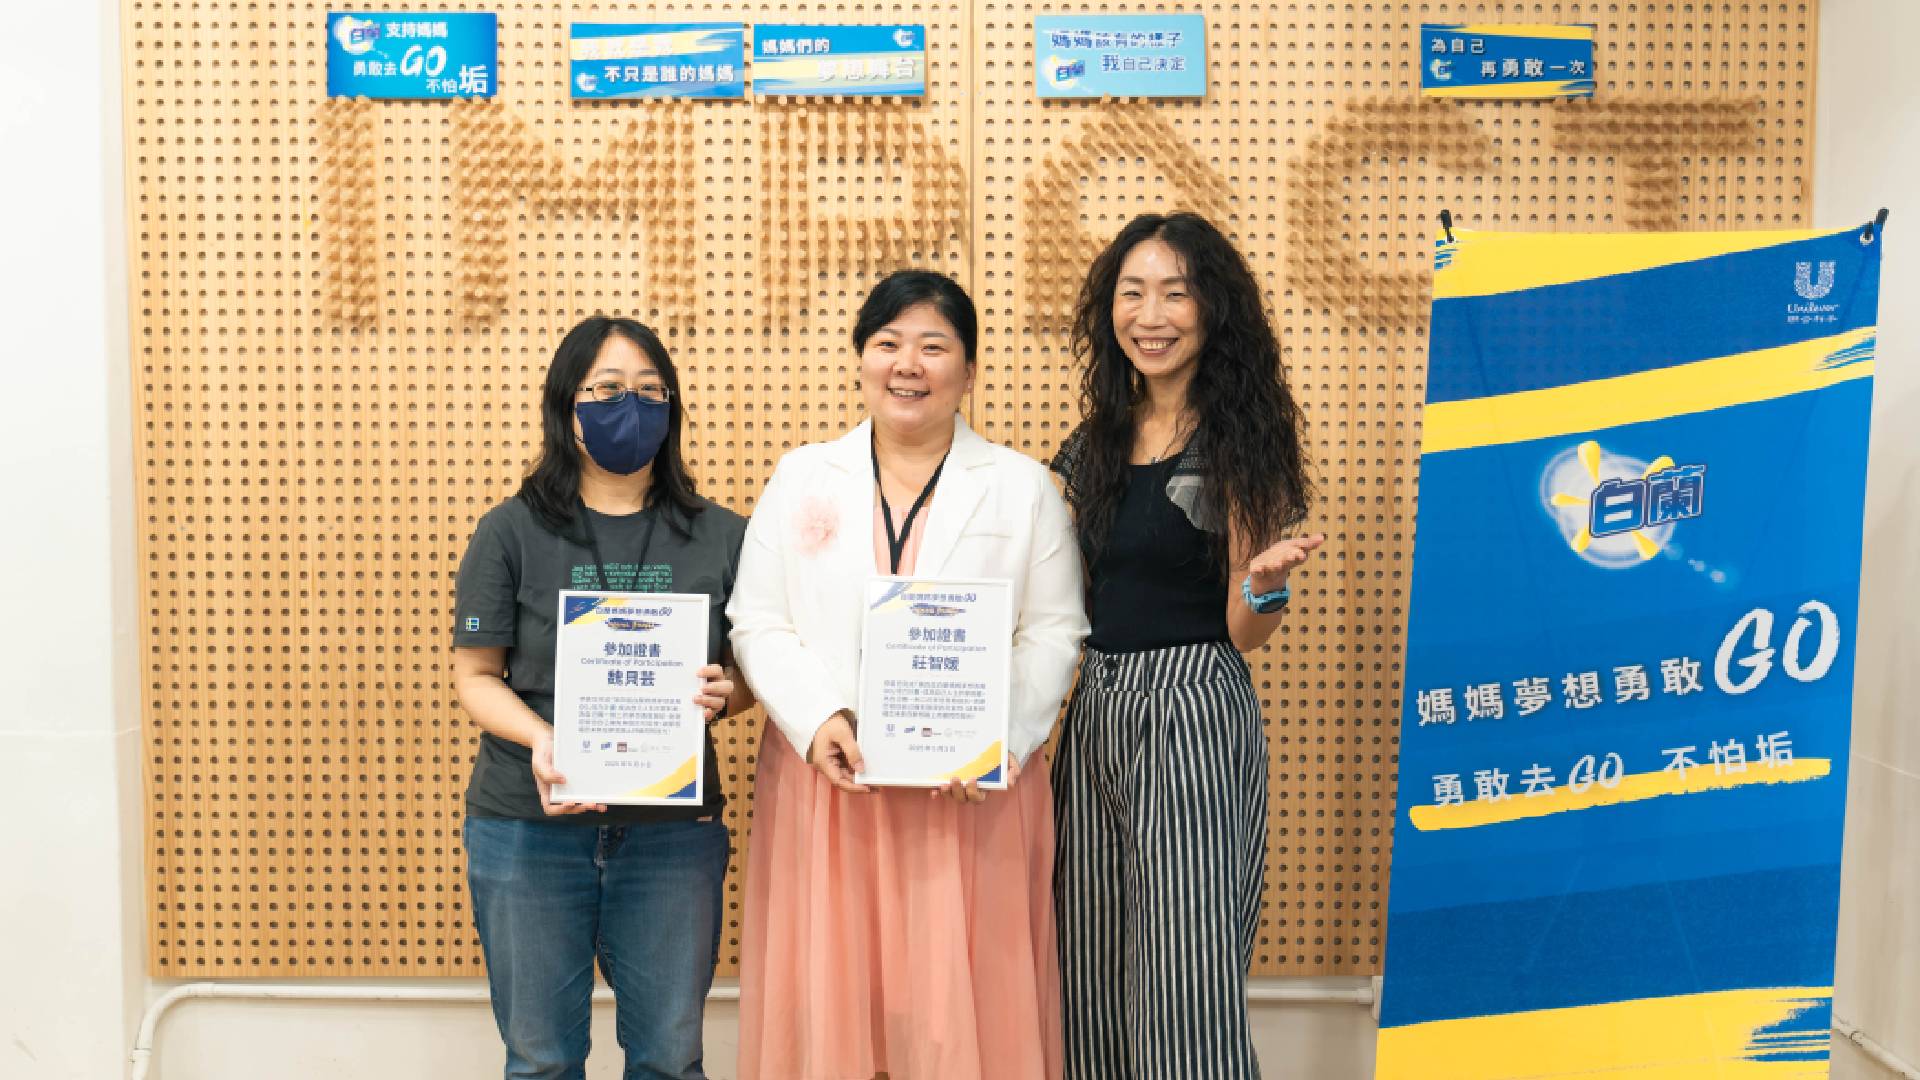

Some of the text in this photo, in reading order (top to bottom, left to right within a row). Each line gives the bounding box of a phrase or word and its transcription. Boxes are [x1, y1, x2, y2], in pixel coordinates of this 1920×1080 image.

[384, 21, 448, 38] 支持媽媽
[762, 38, 830, 54] 媽媽們的
[1051, 30, 1182, 49] 媽媽該有的樣子
[1431, 38, 1484, 54] 為自己
[1102, 54, 1185, 72] 我自己決定
[1481, 58, 1586, 78] 再勇敢一次
[604, 64, 734, 83] 不只是誰的媽媽
[1589, 464, 1707, 539] 白蘭
[908, 627, 966, 643] 參加證書
[603, 641, 661, 657] 參加證書
[1661, 731, 1794, 780] 不怕垢
